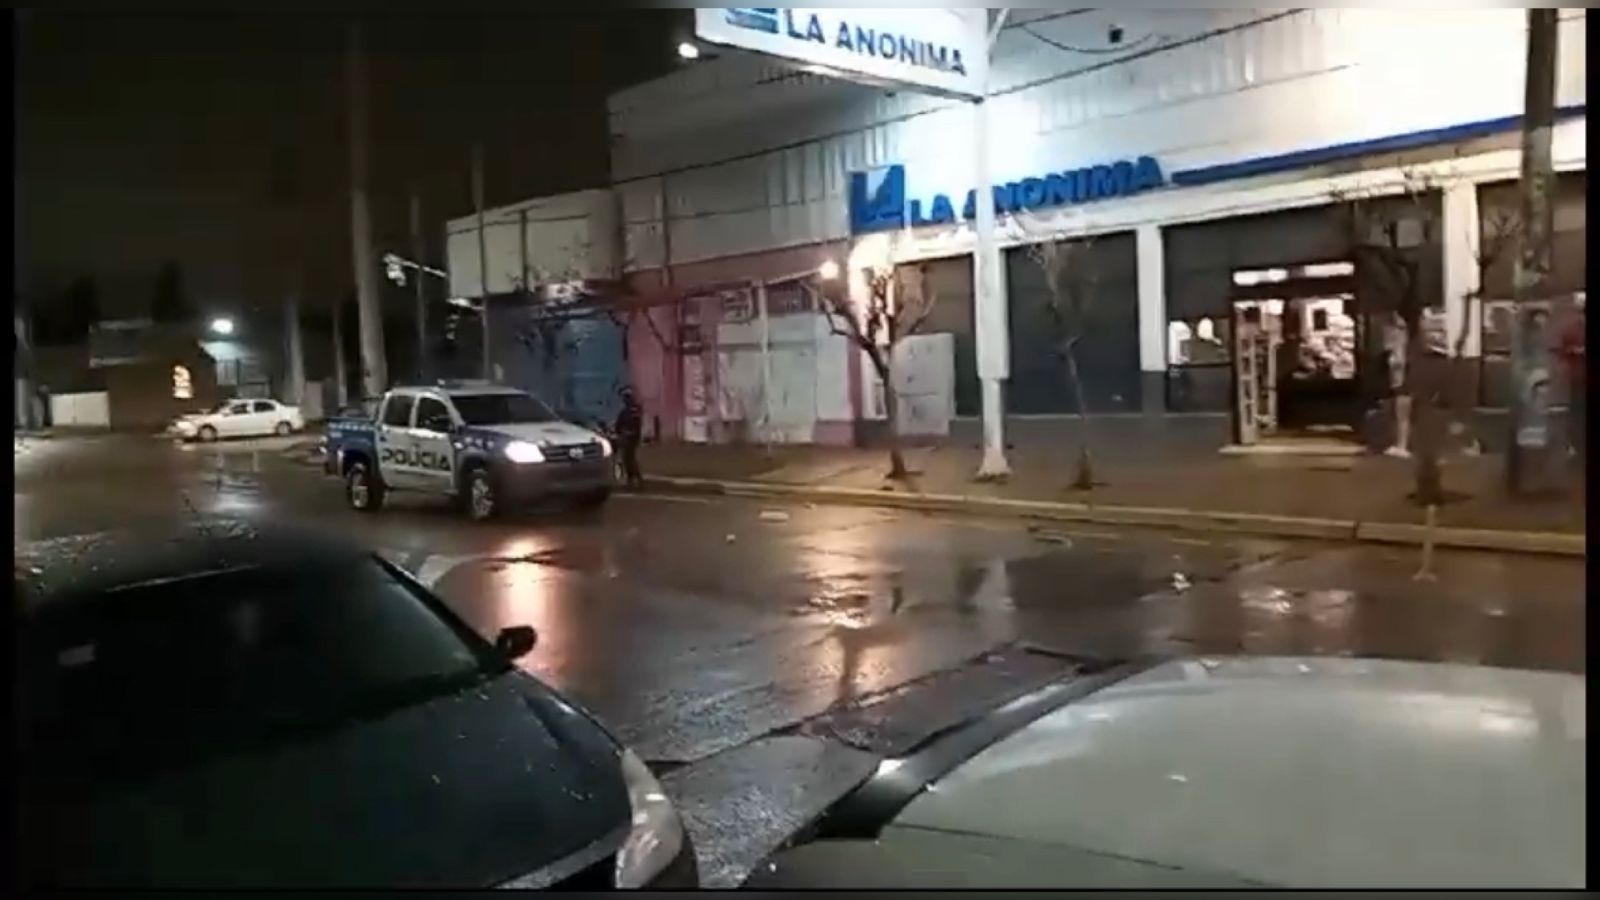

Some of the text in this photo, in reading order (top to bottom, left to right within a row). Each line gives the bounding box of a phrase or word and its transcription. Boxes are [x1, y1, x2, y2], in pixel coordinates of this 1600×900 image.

[787, 8, 825, 43] LA
[836, 20, 967, 76] ANONIMA
[910, 194, 955, 226] LA
